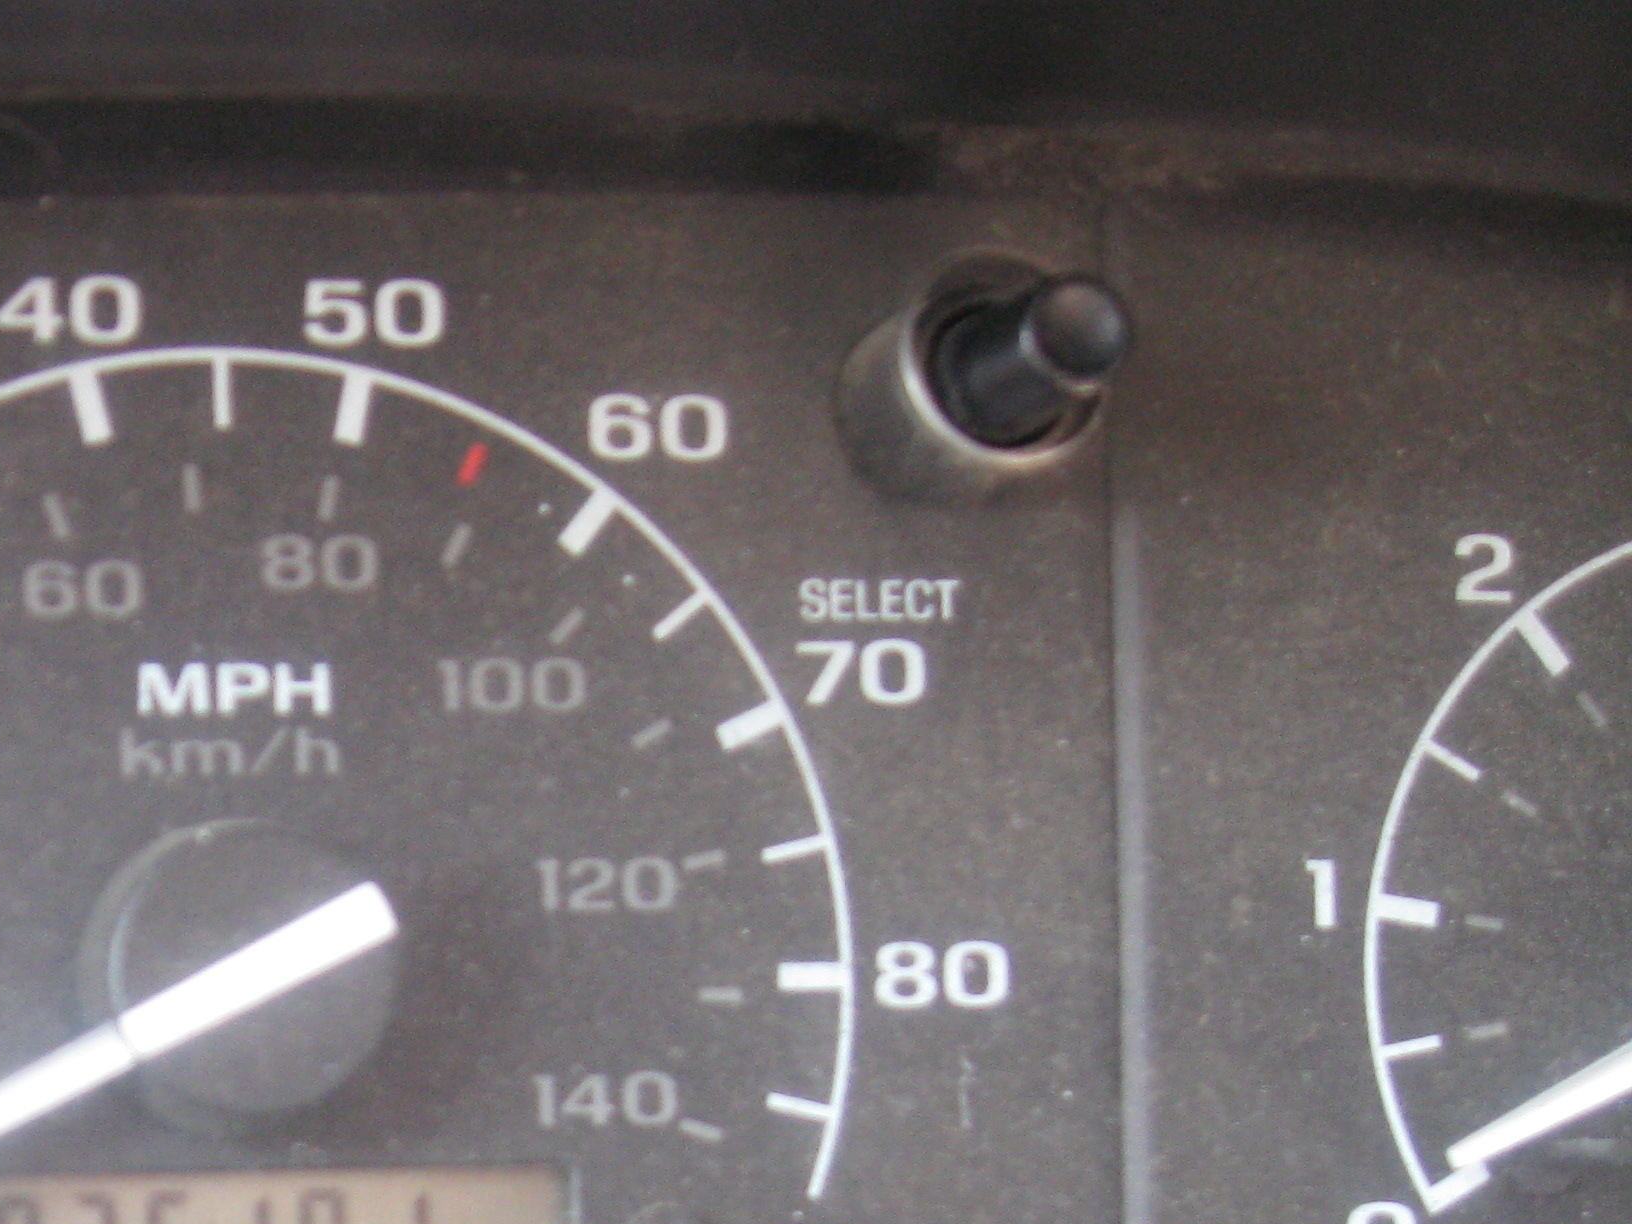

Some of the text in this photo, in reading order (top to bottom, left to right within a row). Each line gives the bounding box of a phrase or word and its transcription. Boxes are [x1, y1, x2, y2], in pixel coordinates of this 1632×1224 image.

[303, 277, 447, 348] 50
[587, 393, 729, 462] 60
[21, 558, 144, 619] 60
[261, 532, 379, 591] 80
[1454, 533, 1514, 604] 2
[798, 576, 961, 624] SELECT
[136, 660, 333, 718] MPH
[436, 656, 588, 715] 100
[793, 637, 928, 708] 70
[120, 725, 341, 778] km/h
[533, 853, 679, 914] 120
[1304, 858, 1339, 930] 1
[873, 938, 1012, 1010] 80
[531, 1069, 680, 1130] 140
